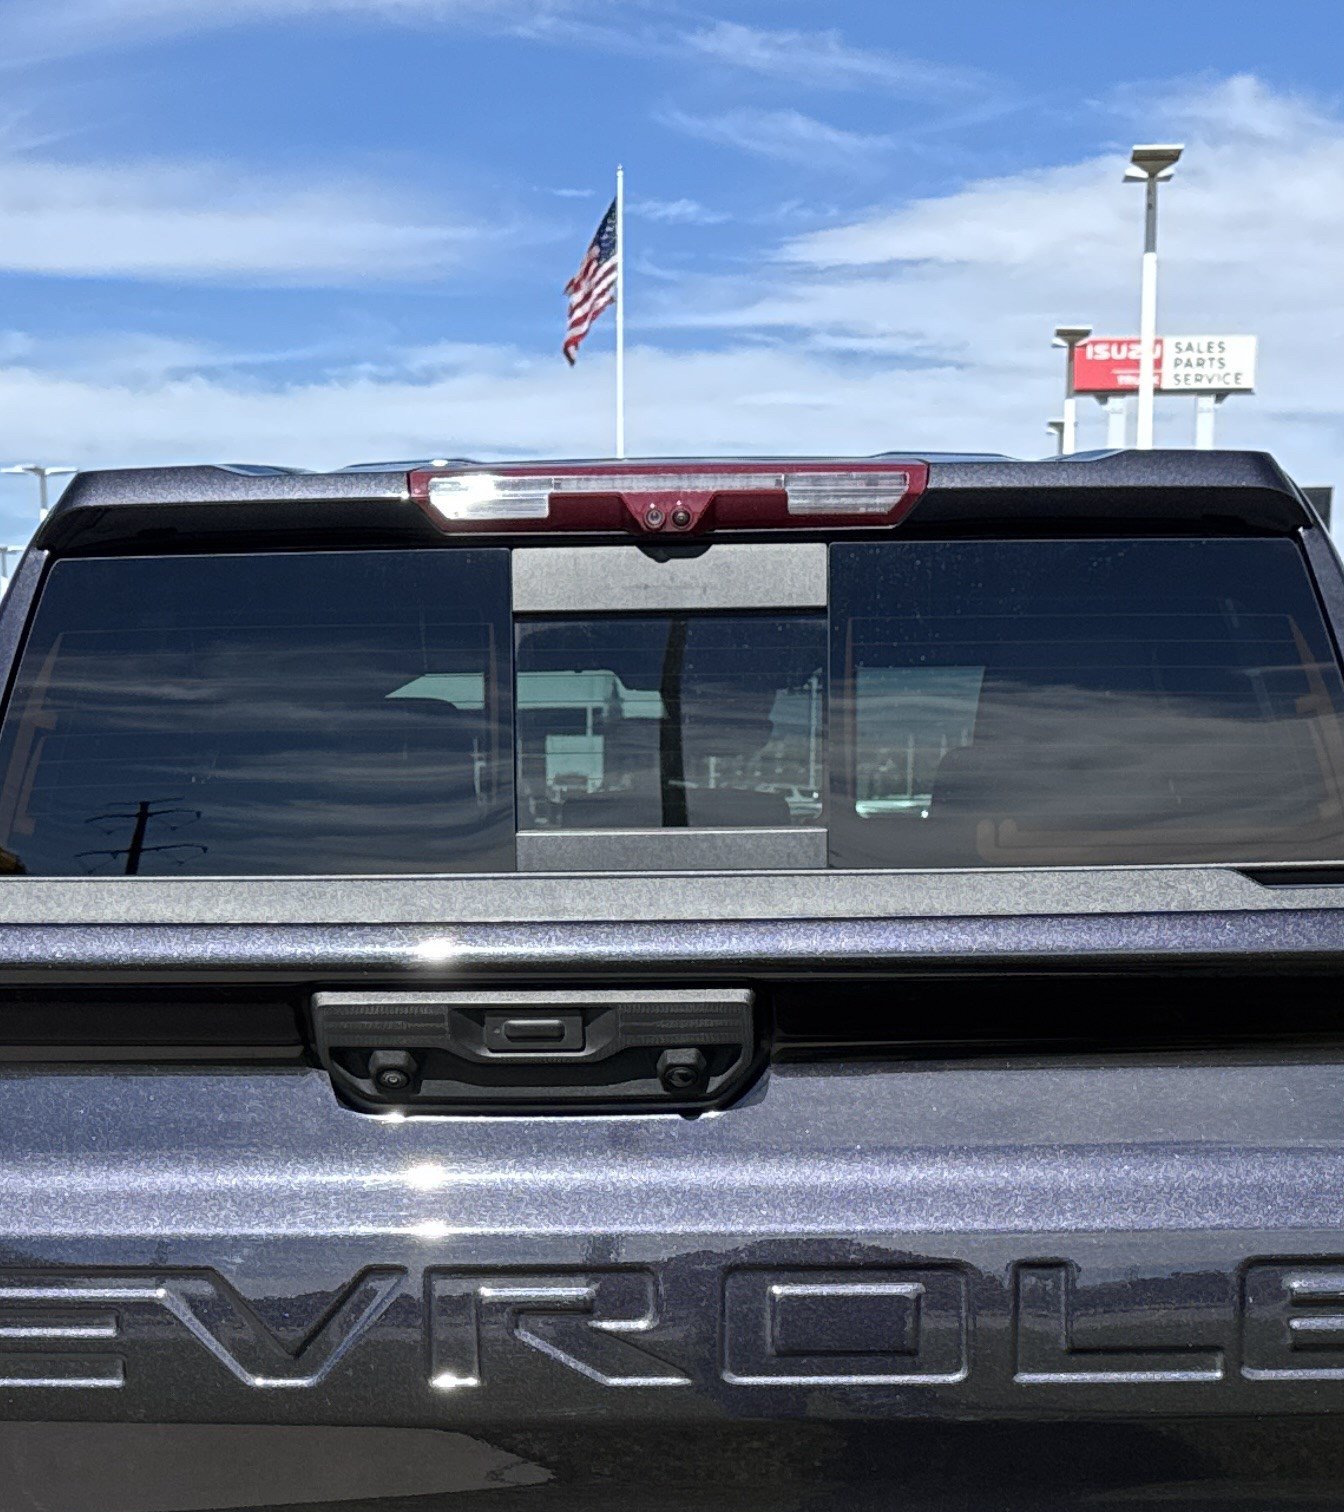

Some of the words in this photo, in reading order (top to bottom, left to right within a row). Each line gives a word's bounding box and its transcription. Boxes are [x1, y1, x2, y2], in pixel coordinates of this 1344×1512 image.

[1174, 341, 1226, 354] SALES
[1173, 357, 1226, 369] PARTS
[1173, 373, 1243, 386] SERVICE
